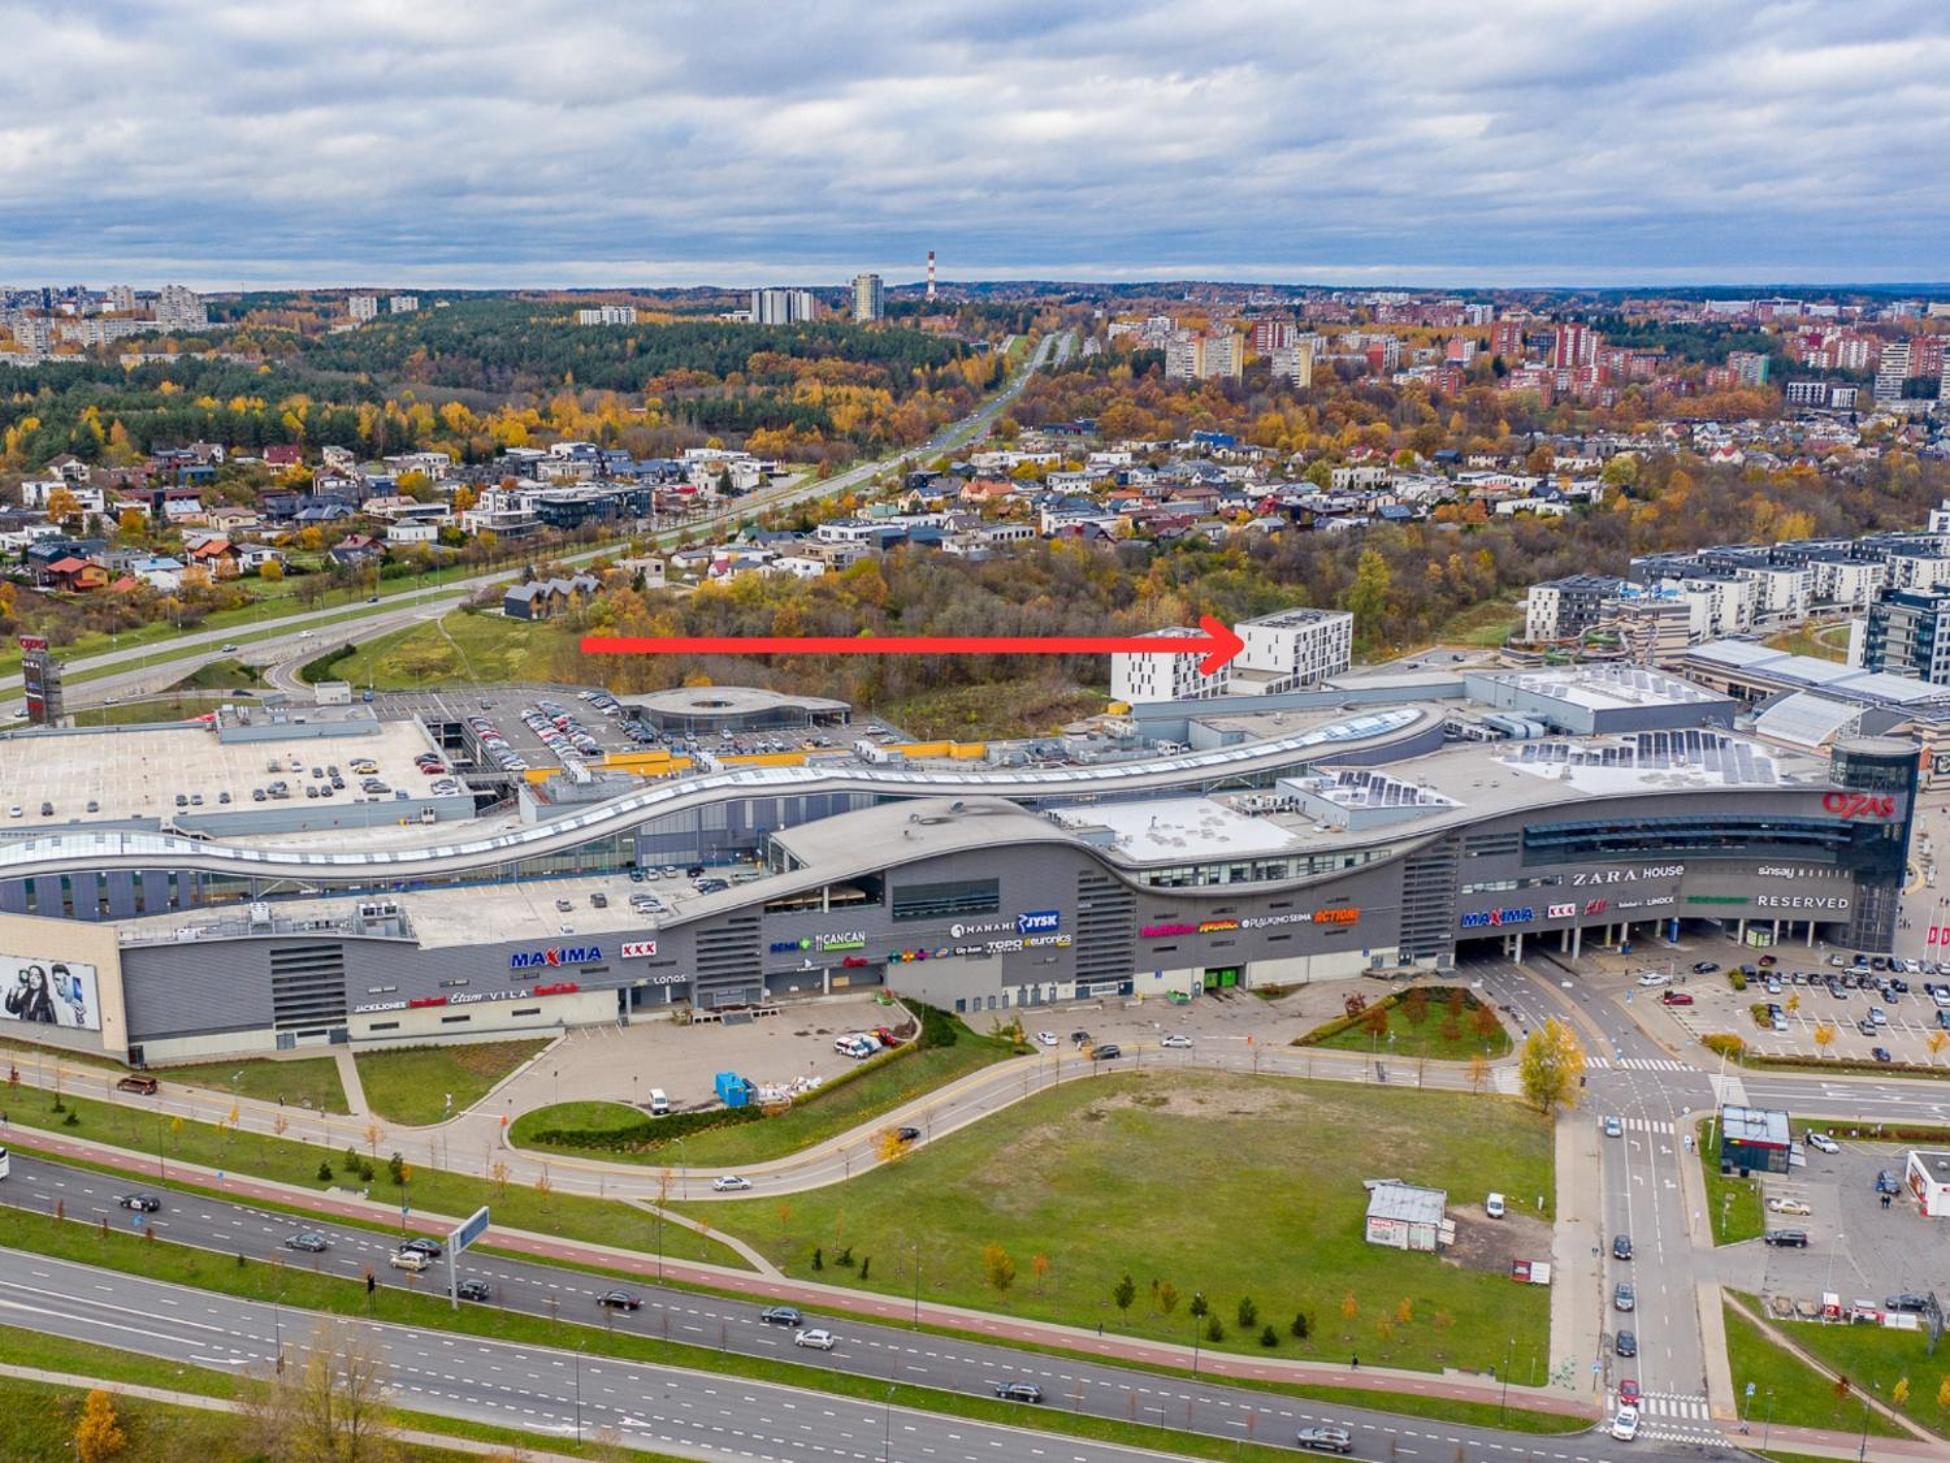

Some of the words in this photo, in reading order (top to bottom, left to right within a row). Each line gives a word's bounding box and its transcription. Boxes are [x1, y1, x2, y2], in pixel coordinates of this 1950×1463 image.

[1822, 791, 1895, 819] OZAS
[1573, 869, 1637, 886] ZARA
[1758, 865, 1794, 879] sinsay
[1758, 895, 1849, 909] RESERVED
[1026, 915, 1057, 928] JYSK
[1462, 907, 1534, 927] MAXIMA
[623, 943, 655, 956] XXX
[987, 939, 1023, 949] TOPO
[510, 946, 603, 967] MAXIMA
[450, 992, 482, 1004] Etam
[489, 990, 527, 1001] VILA
